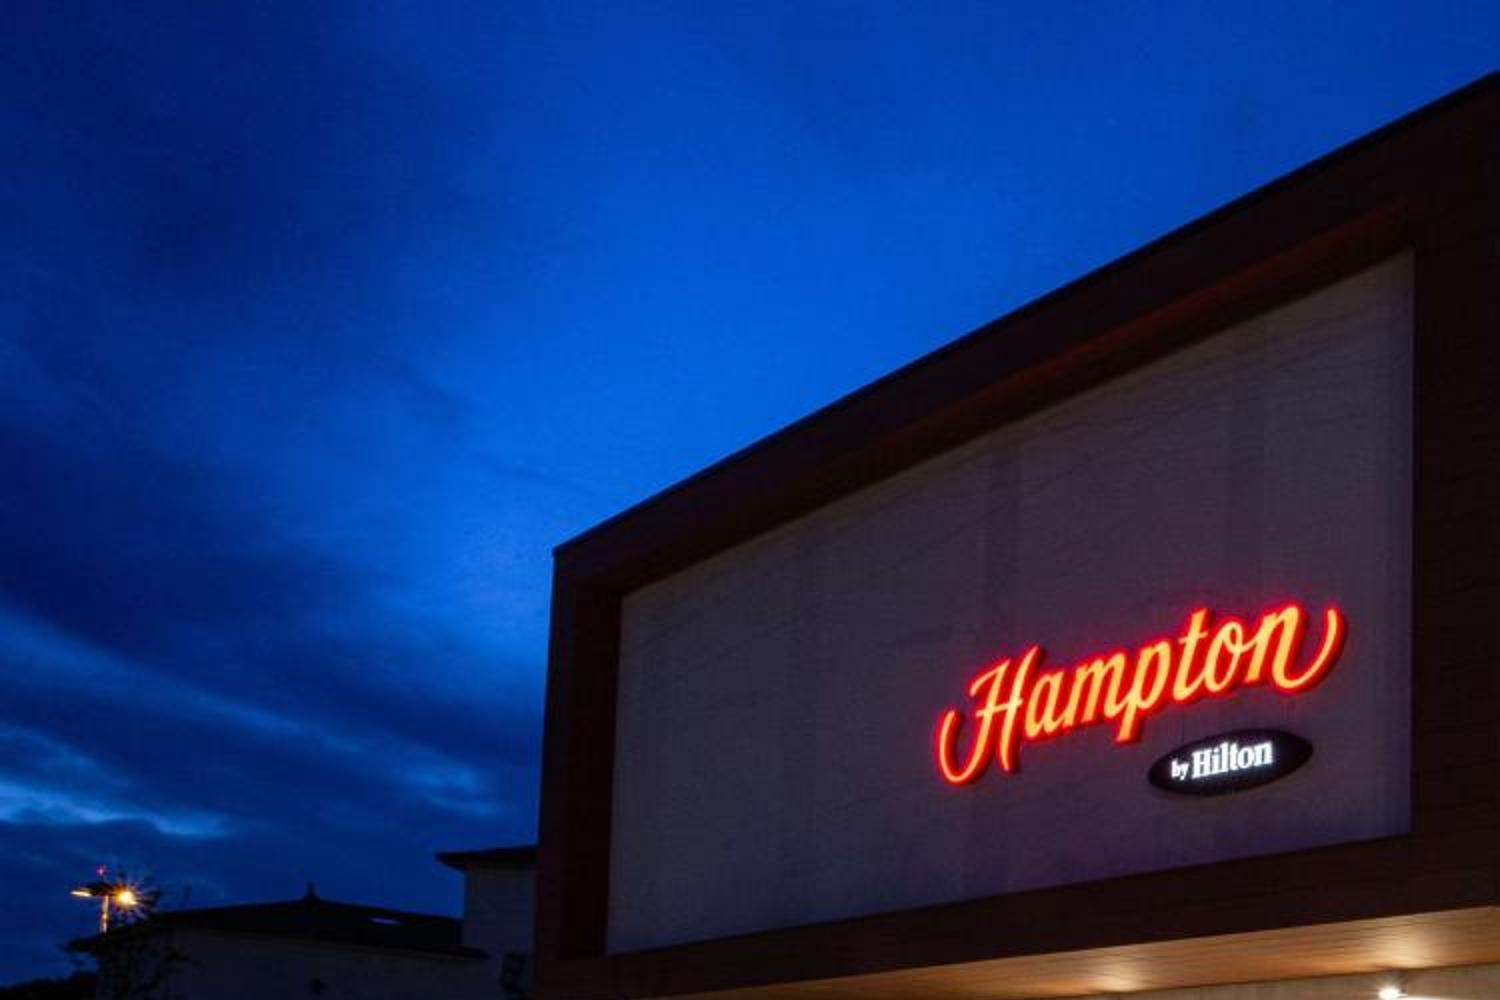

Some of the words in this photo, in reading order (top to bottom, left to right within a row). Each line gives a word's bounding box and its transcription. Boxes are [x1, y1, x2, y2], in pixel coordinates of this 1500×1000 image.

[937, 604, 1345, 785] Hampton
[1171, 758, 1189, 781] by
[1191, 740, 1273, 779] Hilton
